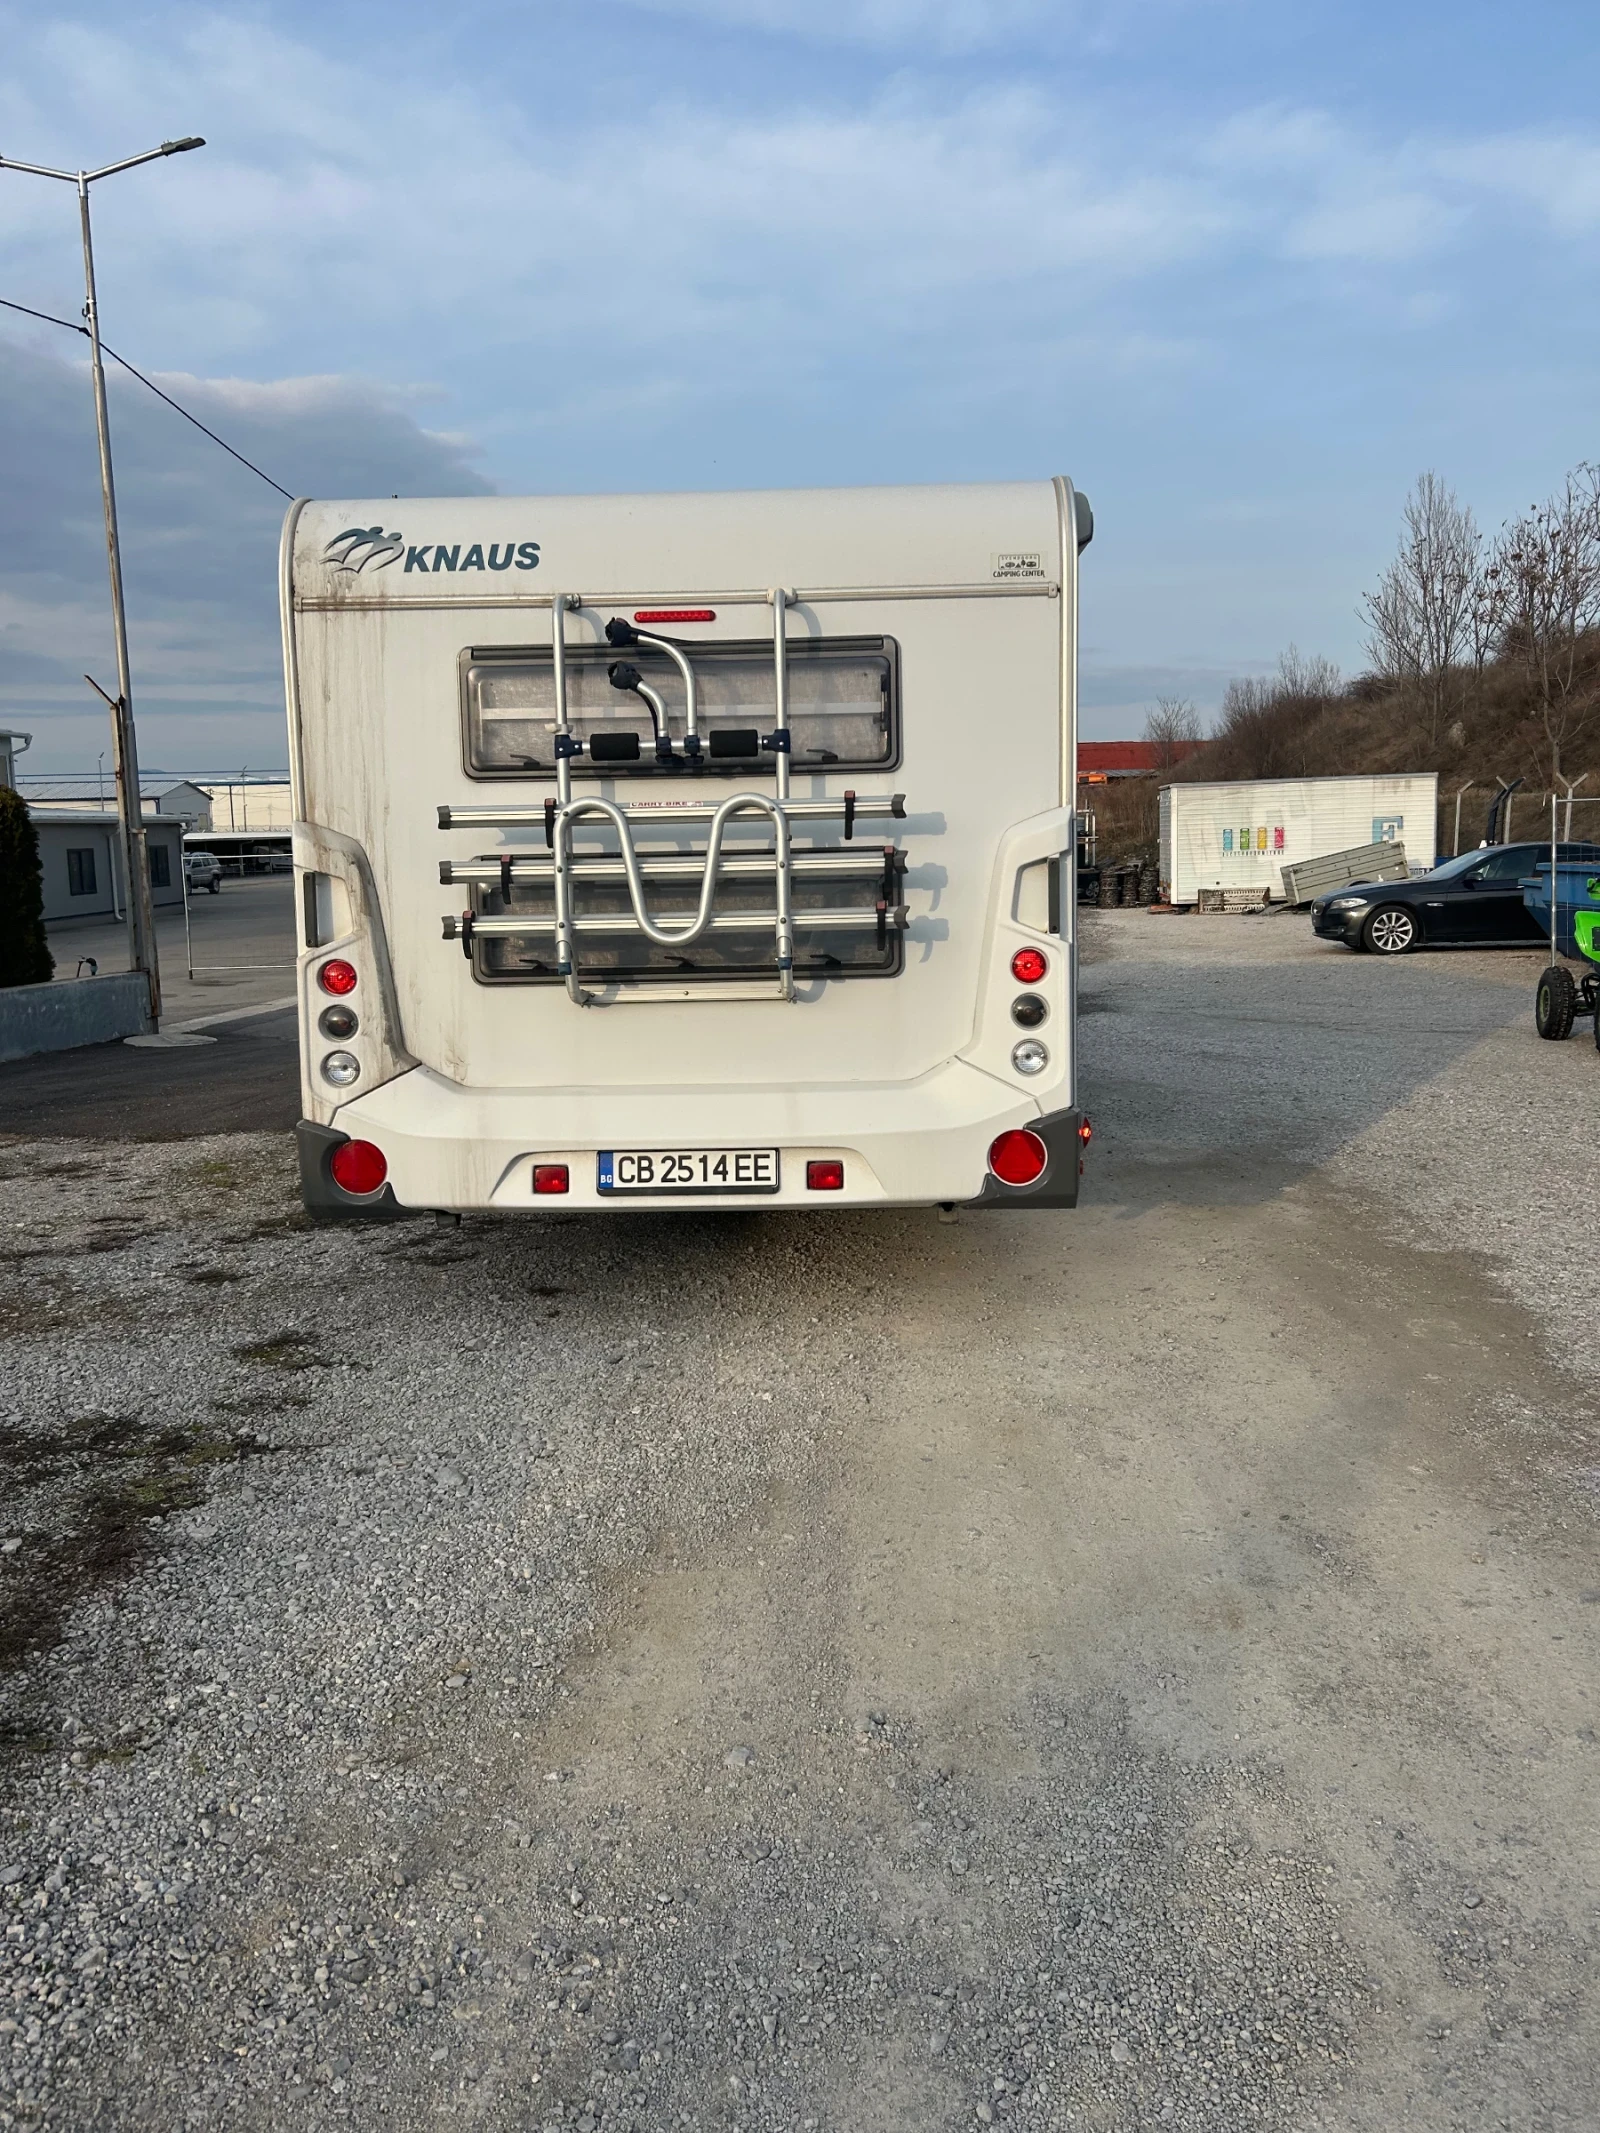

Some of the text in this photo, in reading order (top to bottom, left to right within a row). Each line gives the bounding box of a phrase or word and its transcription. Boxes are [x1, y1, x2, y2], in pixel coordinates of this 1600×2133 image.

[403, 542, 541, 573] KNAUS
[992, 569, 1046, 578] CAMPING CENTER
[600, 1174, 613, 1184] BG
